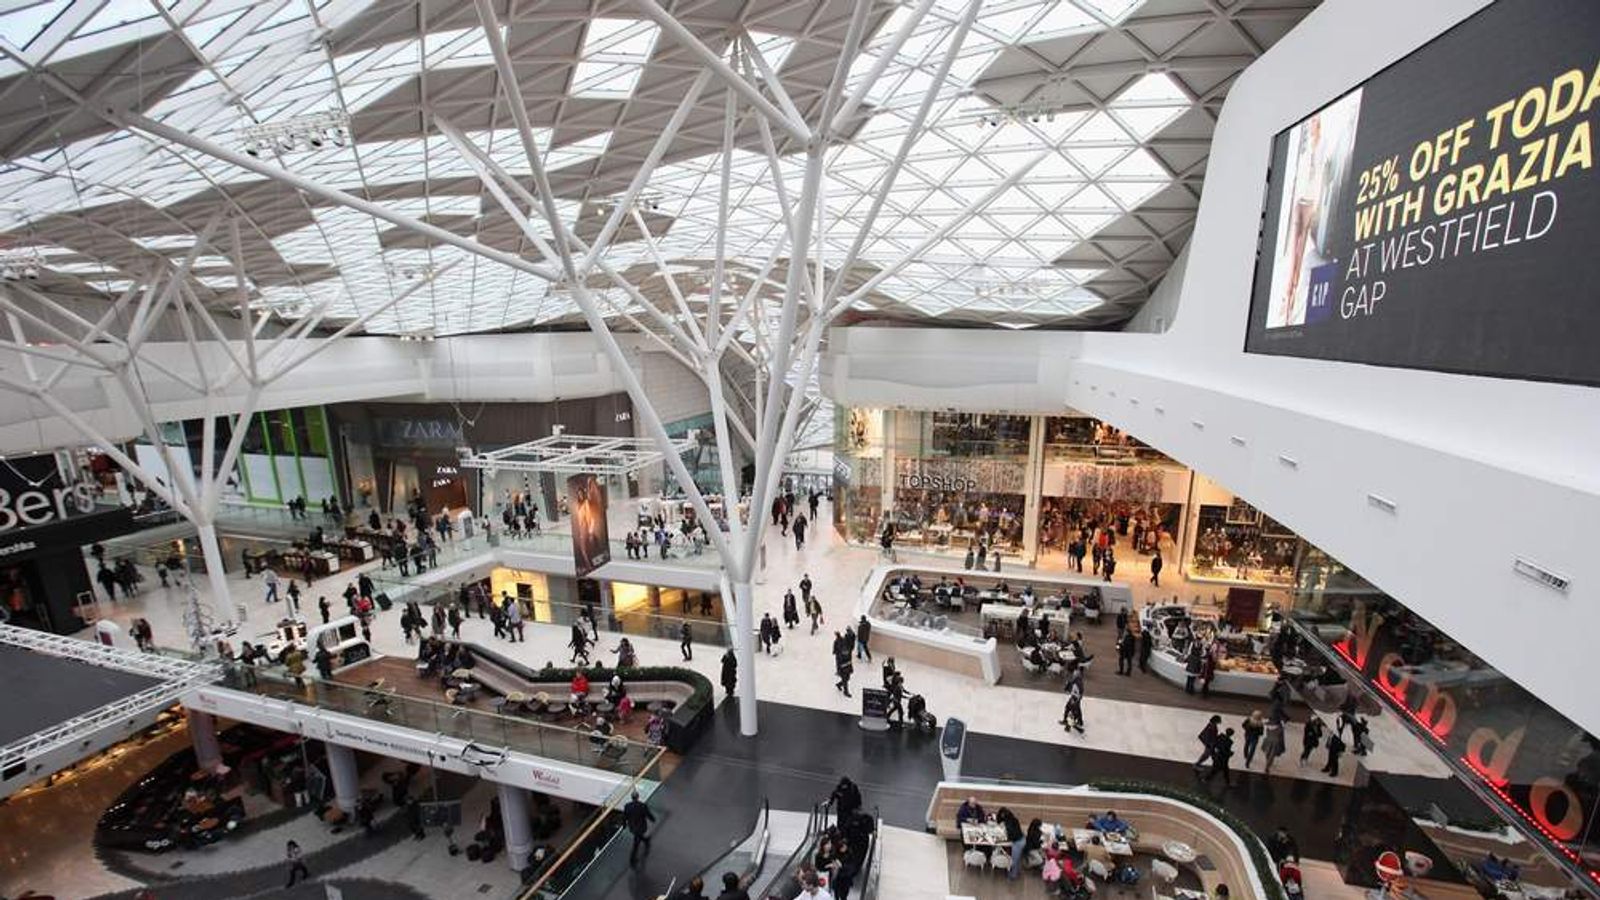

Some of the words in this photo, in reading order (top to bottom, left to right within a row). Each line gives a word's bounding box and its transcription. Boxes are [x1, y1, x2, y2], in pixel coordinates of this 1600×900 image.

[1354, 183, 1422, 242] WITH
[1433, 121, 1592, 222] GRAZIA
[1357, 153, 1400, 206] 25%
[1409, 118, 1473, 182] OFF
[1345, 242, 1376, 281] AT
[1380, 191, 1558, 273] WESTFIELD
[1312, 282, 1330, 307] GAP
[1340, 281, 1386, 320] GAP
[403, 420, 458, 438] ZARA
[899, 473, 977, 493] TOPSHOP
